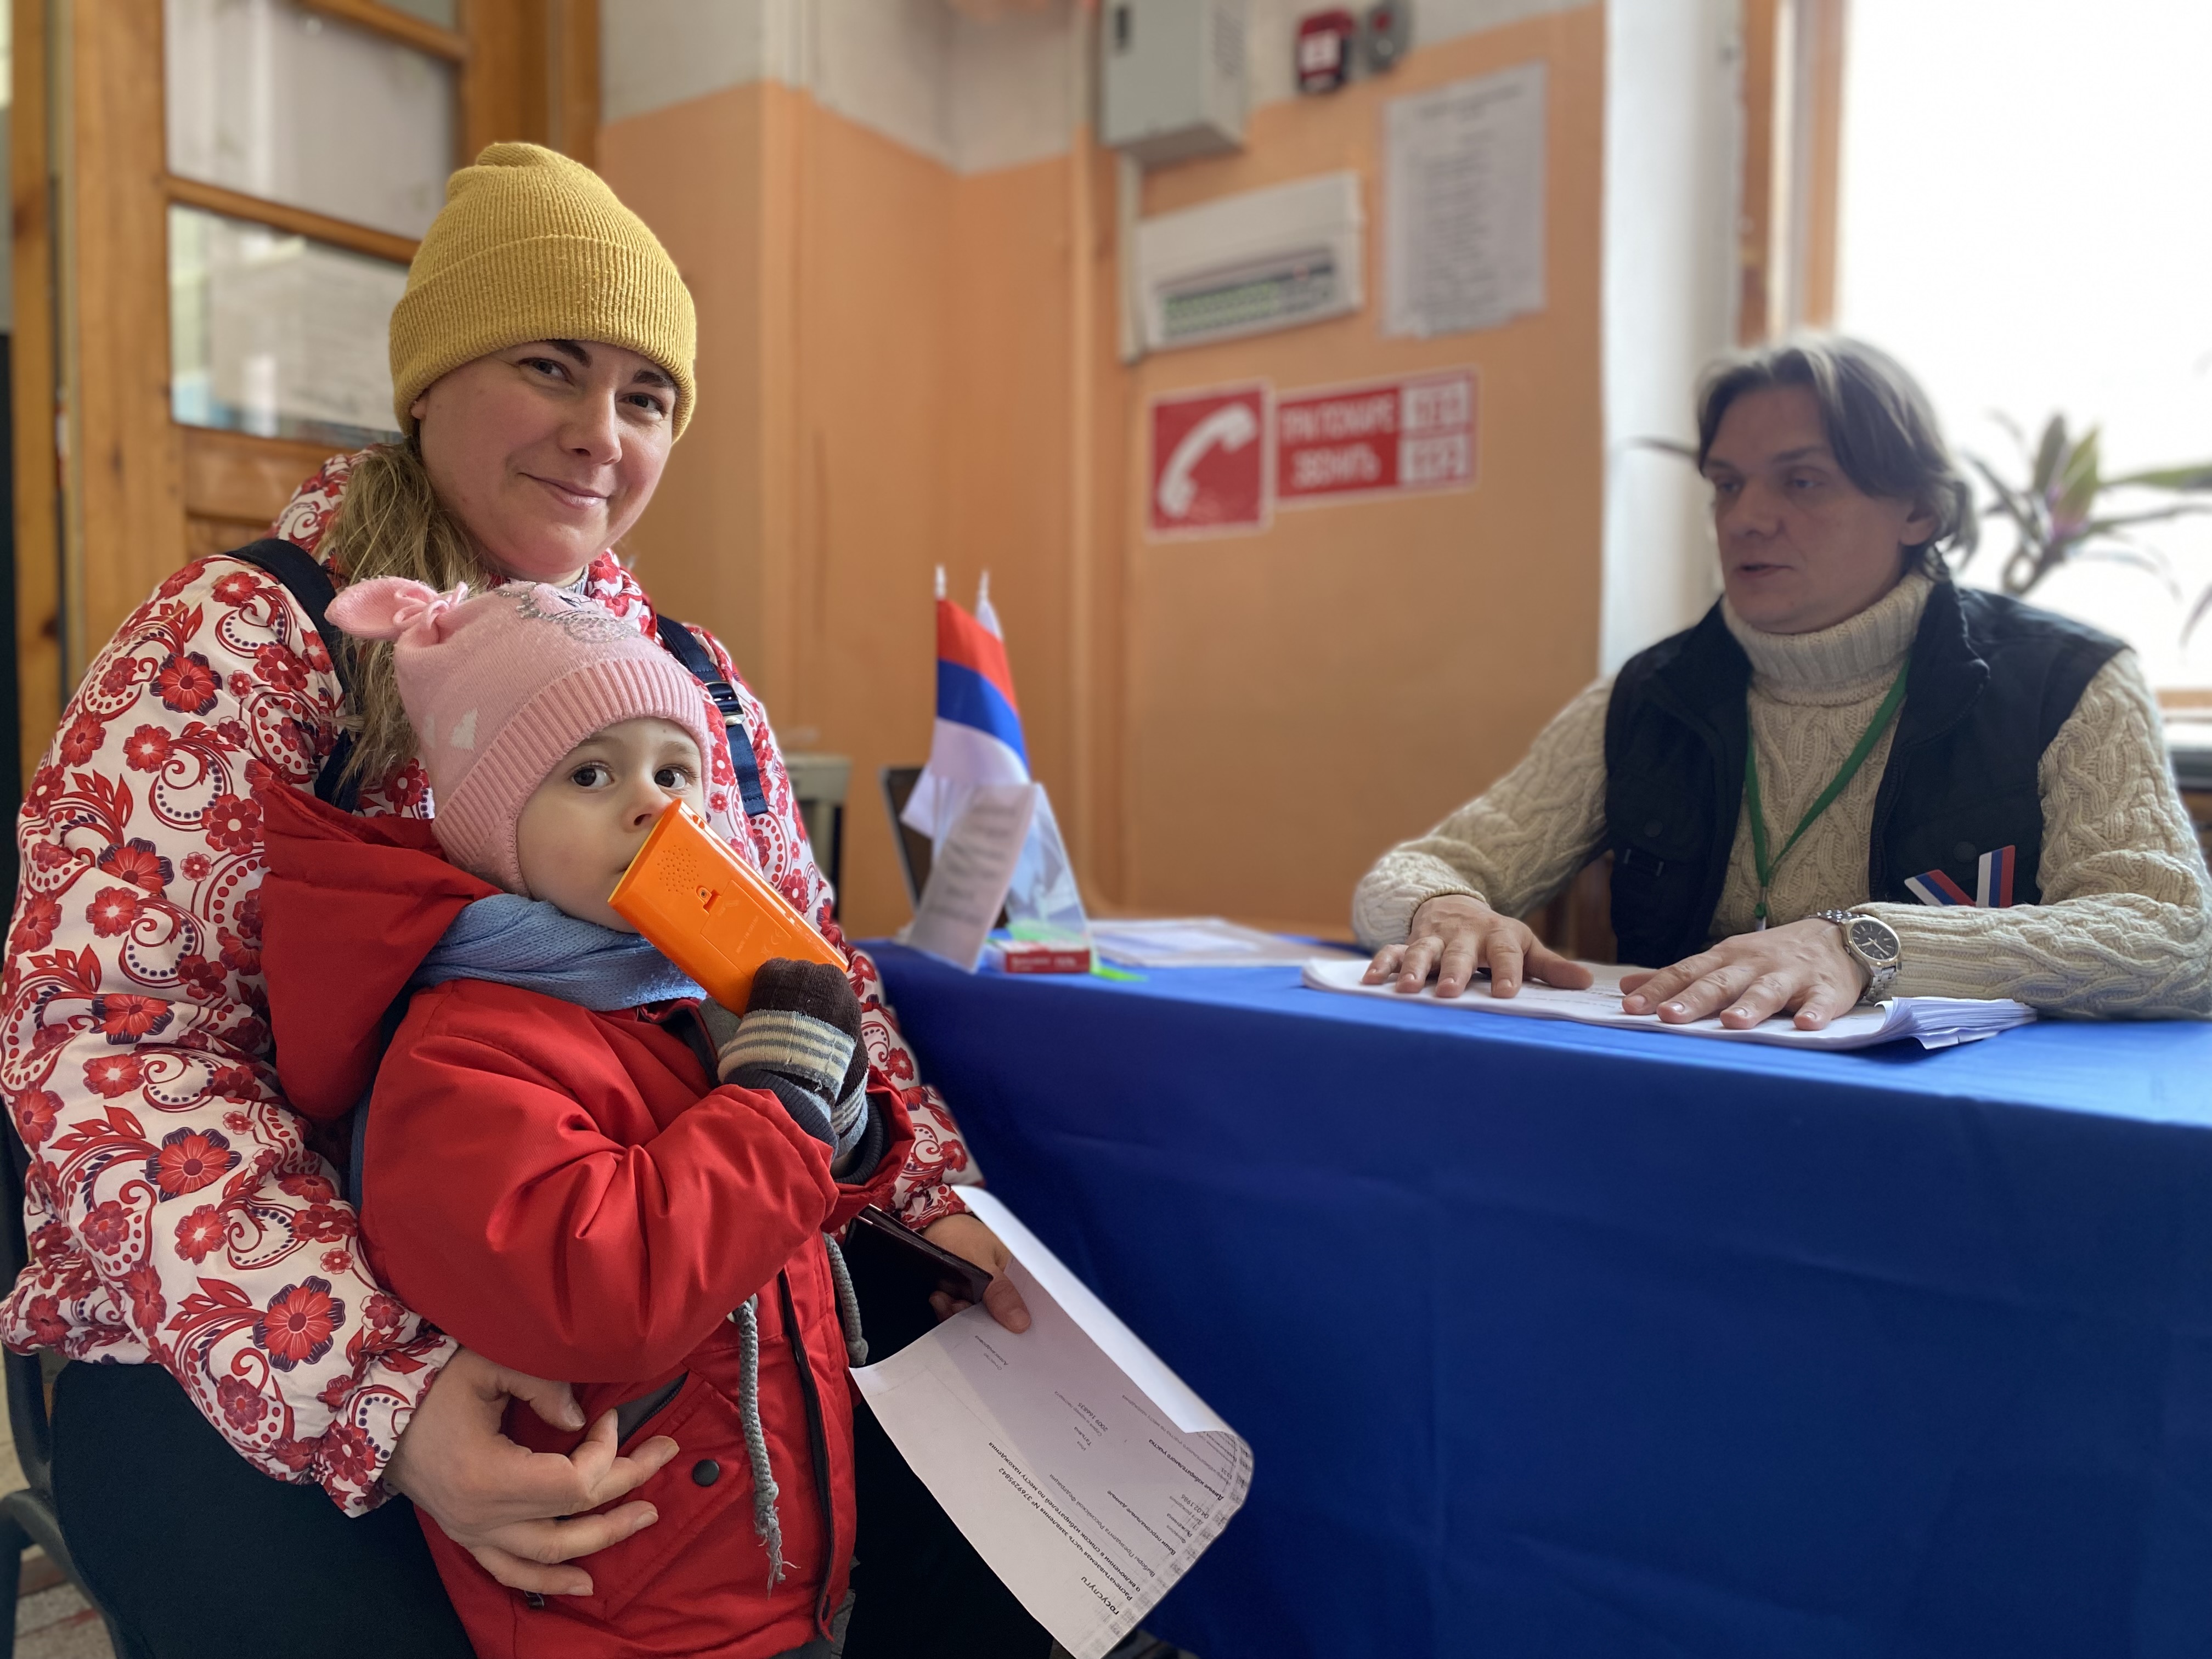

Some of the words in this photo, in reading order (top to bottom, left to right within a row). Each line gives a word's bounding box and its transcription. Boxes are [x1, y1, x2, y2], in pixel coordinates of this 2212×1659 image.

[974, 1335, 1009, 1365] Александровна
[1074, 1426, 1092, 1446] Татьяна
[1095, 1419, 1108, 1432] 2009
[989, 1442, 1022, 1475] нахождения
[1148, 1439, 1167, 1455] участка
[1021, 1474, 1038, 1491] месту
[1167, 1454, 1204, 1485] избирательного
[998, 1467, 1032, 1501] 3769295842
[1037, 1490, 1046, 1498] по
[1049, 1474, 1076, 1502] Федерации
[1204, 1484, 1224, 1501] Данные
[1031, 1501, 1040, 1509] №
[1107, 1491, 1128, 1508] данные
[1040, 1508, 1068, 1536] заявления
[1045, 1498, 1081, 1533] избирателей
[1076, 1500, 1105, 1530] Российской
[1126, 1508, 1162, 1542] персональные
[1069, 1536, 1084, 1552] часть
[1080, 1532, 1101, 1553] список
[1105, 1528, 1135, 1558] Президента
[1161, 1541, 1176, 1556] Ваши
[1084, 1551, 1133, 1601] Распечатываемая
[1104, 1556, 1136, 1588] включении
[1134, 1556, 1155, 1578] Выборы
[1081, 1576, 1120, 1615] госуслуги
